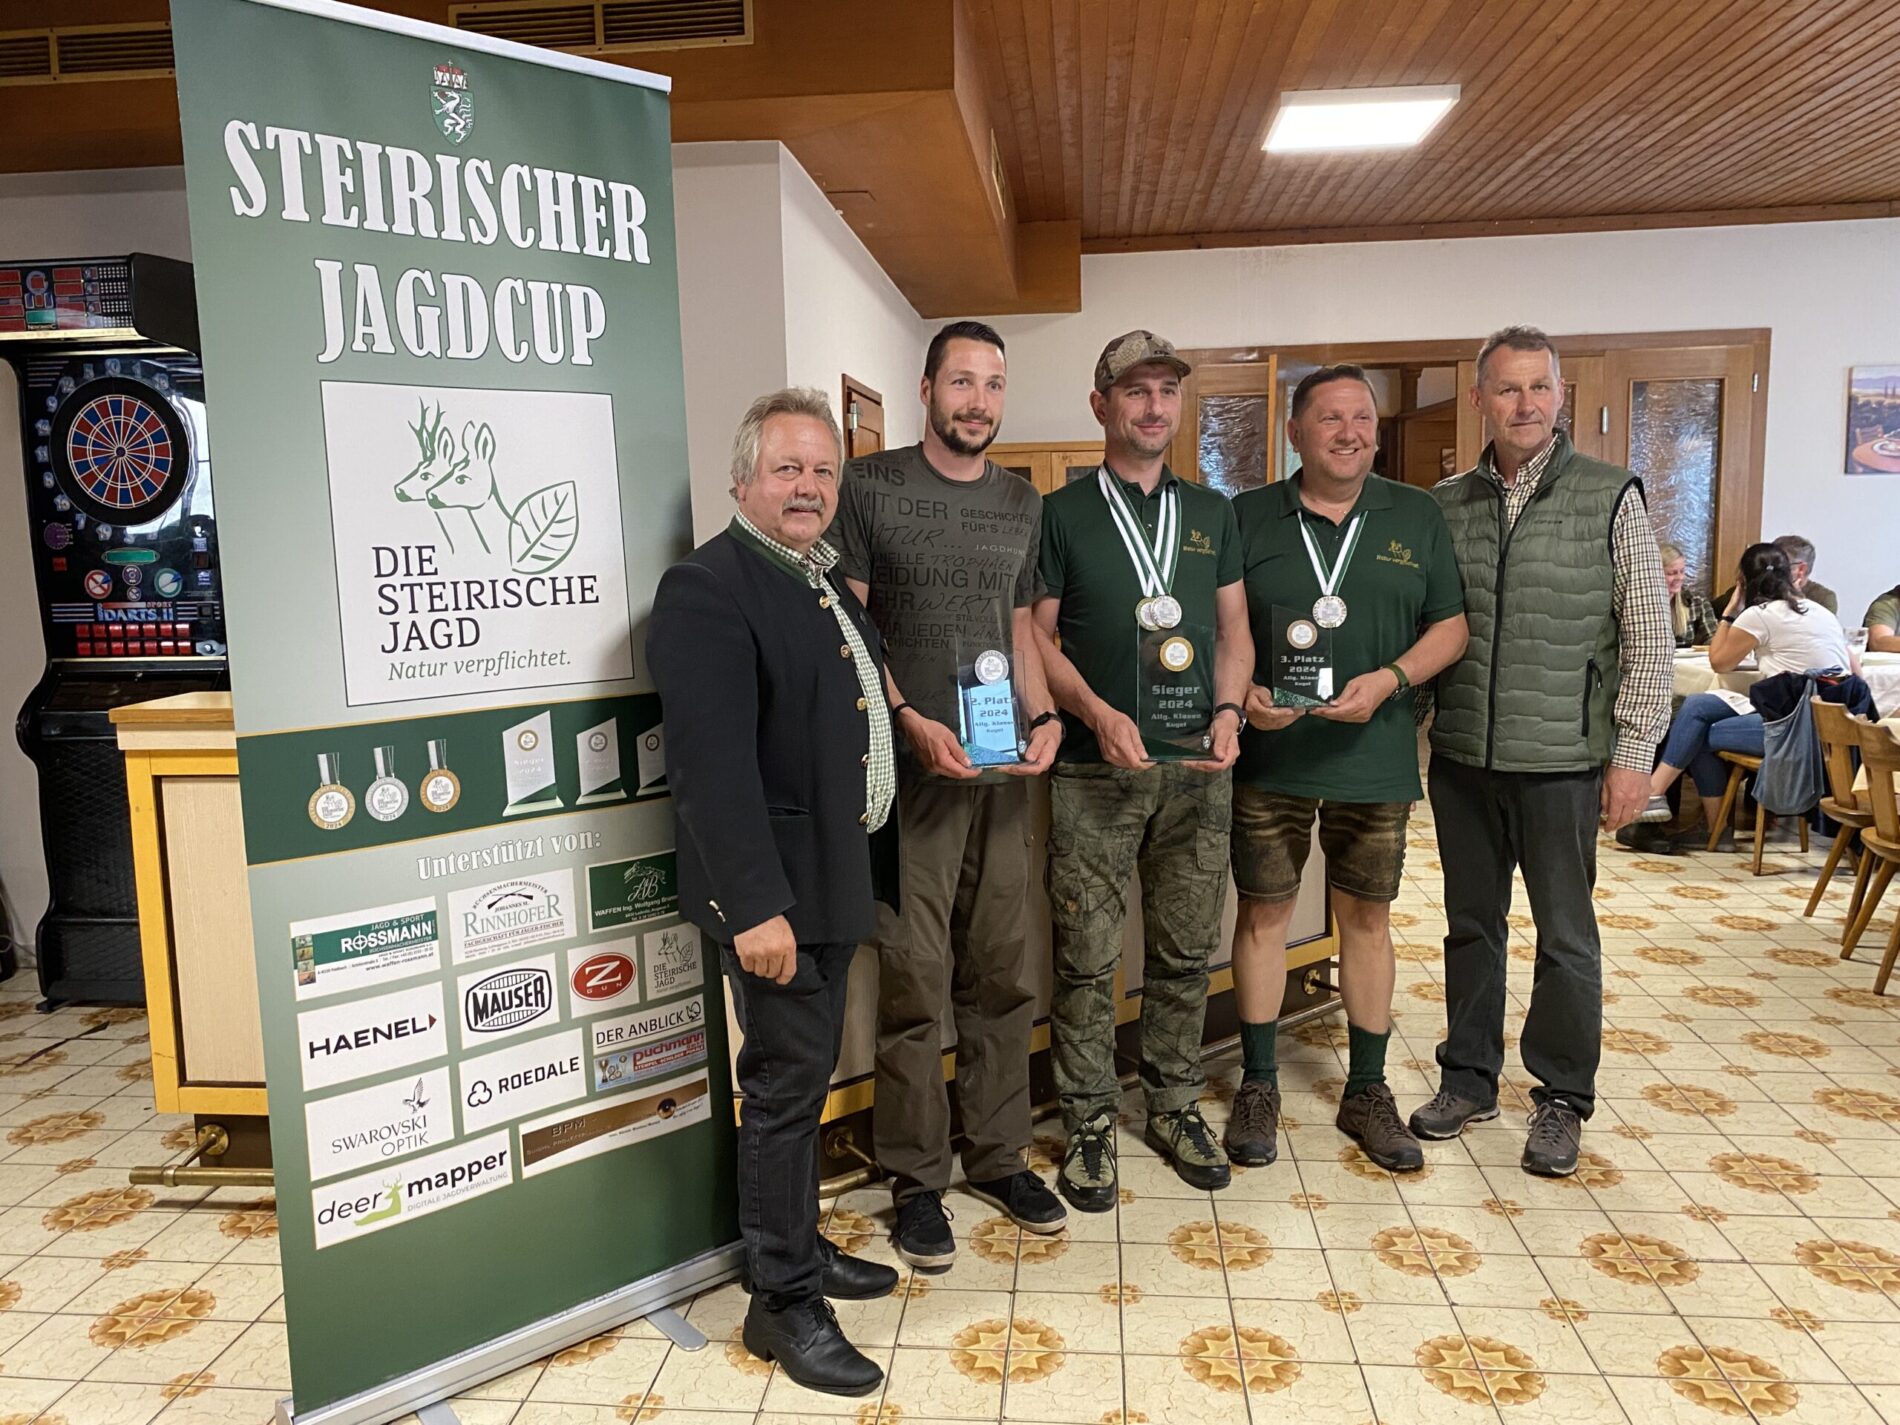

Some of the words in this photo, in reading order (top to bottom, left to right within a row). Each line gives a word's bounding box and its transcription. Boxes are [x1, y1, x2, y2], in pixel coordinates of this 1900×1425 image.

[223, 119, 652, 265] STEIRISCHER
[314, 258, 607, 366] JAGDCUP
[898, 496, 948, 520] DER
[371, 545, 438, 578] DIE
[873, 566, 969, 589] EIDUNG
[978, 569, 1015, 592] MIT
[378, 575, 599, 615] STEIRISCHE
[918, 592, 1000, 615] WERT
[104, 608, 158, 621] DARTS
[381, 617, 481, 653] JAGD
[909, 623, 967, 639] JEDEN
[388, 660, 448, 681] Natur
[454, 649, 572, 677] verpflichtet.
[1280, 655, 1291, 664] 3.
[1294, 655, 1325, 663] Platz
[1151, 684, 1200, 697] Sieger
[1158, 699, 1194, 709] 2024
[980, 709, 1008, 718] 2024
[416, 834, 544, 881] Unterstützt
[552, 829, 602, 856] von:
[371, 920, 390, 931] JAGD
[392, 918, 399, 926] &
[400, 914, 425, 925] SPORT
[463, 894, 562, 938] RINNHOFER
[594, 905, 622, 917] WAFFEN
[340, 920, 433, 954] ROSSMANN
[585, 960, 622, 988] Z
[653, 963, 667, 973] DIE
[653, 961, 697, 981] STEIRISCHE
[655, 976, 675, 989] JAGD
[472, 975, 546, 1027] MAUSER
[309, 1016, 428, 1059] HAENEL
[596, 1027, 624, 1045] DER
[628, 1010, 684, 1037] ANBLICK
[498, 1056, 580, 1094] ROEDALE
[332, 1114, 428, 1154] SWAROVSKI
[552, 1118, 586, 1138] BPM
[381, 1131, 429, 1156] OPTIK
[318, 1190, 383, 1225] deer
[407, 1150, 508, 1198] mapper
